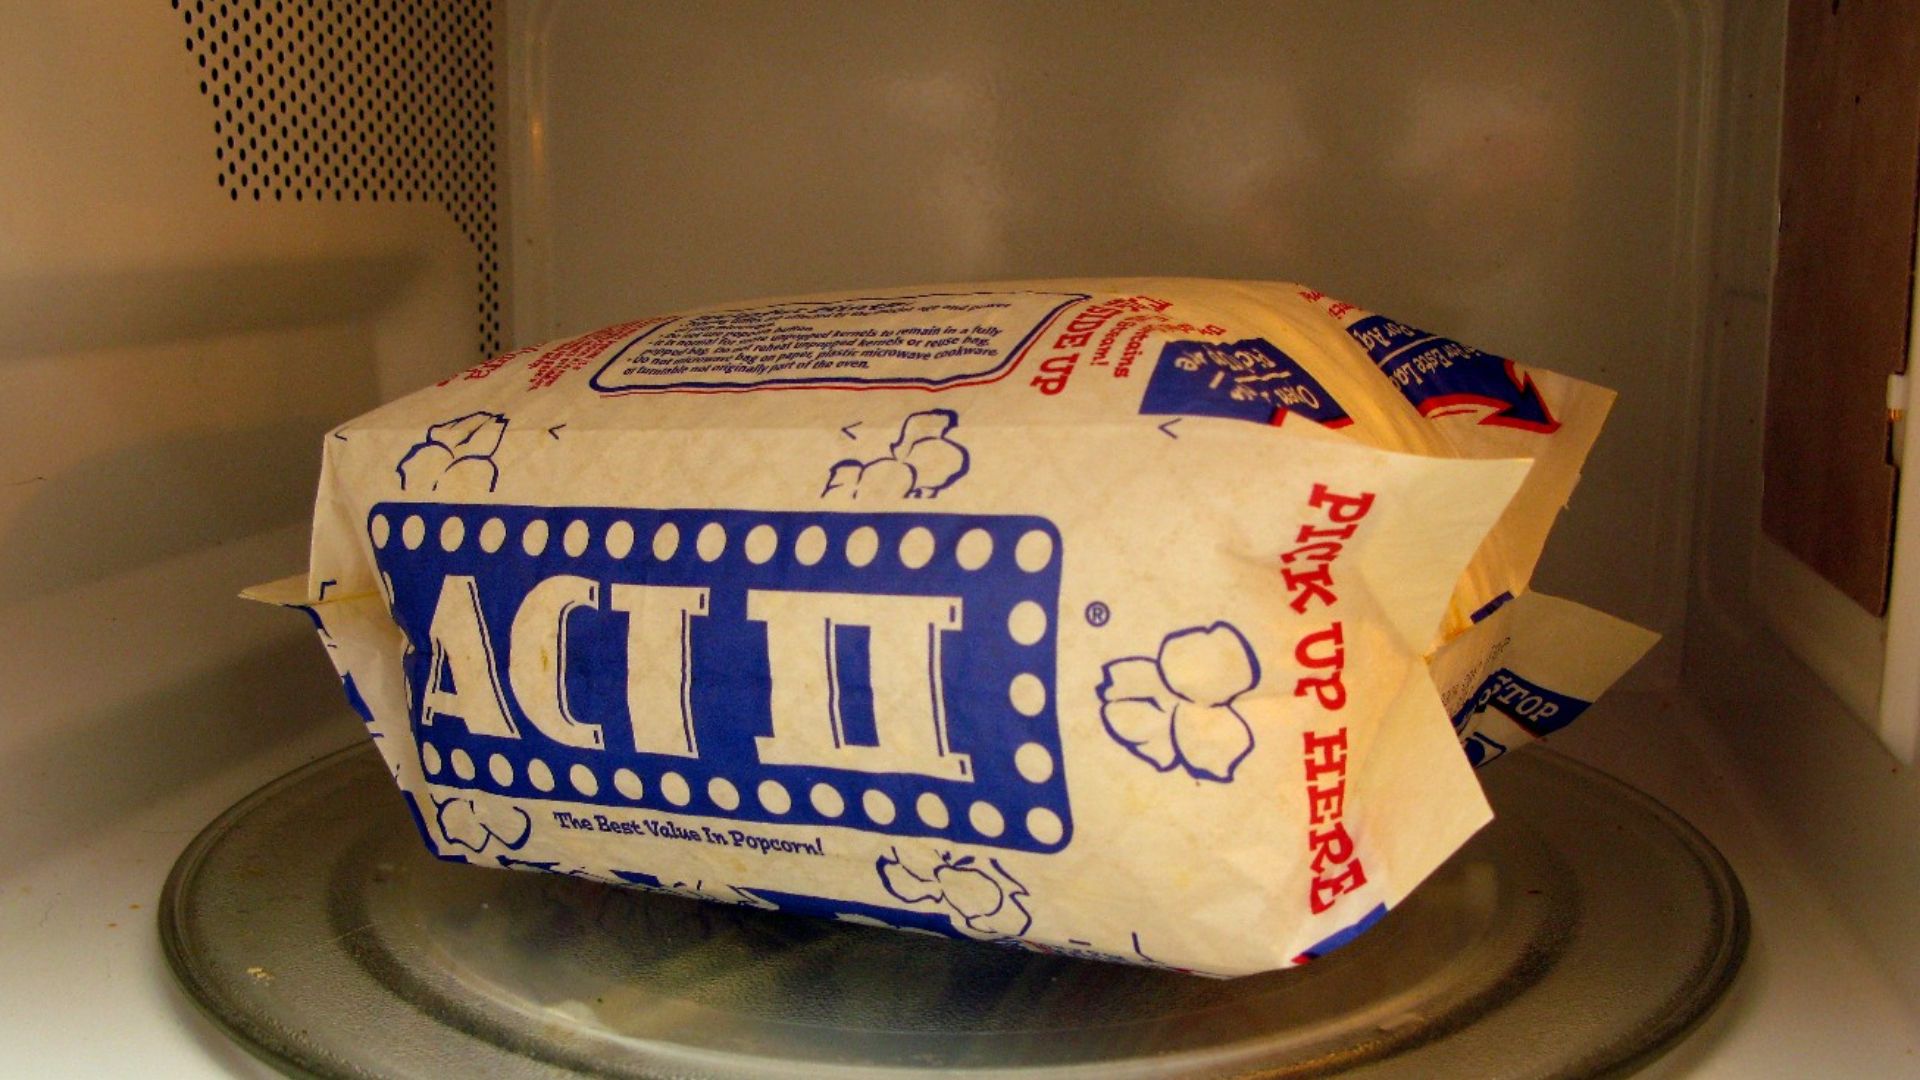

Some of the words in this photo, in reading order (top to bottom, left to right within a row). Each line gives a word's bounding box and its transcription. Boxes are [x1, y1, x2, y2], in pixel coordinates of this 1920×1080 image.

[1030, 351, 1080, 396] UP
[1280, 483, 1376, 615] PICK
[422, 573, 711, 759] ACT
[1293, 621, 1347, 711] UP
[552, 810, 592, 832] The
[594, 814, 645, 836] Best
[643, 819, 702, 843] Value
[701, 826, 729, 847] In
[728, 829, 825, 856] Popcorn!
[1302, 727, 1368, 915] HERE
